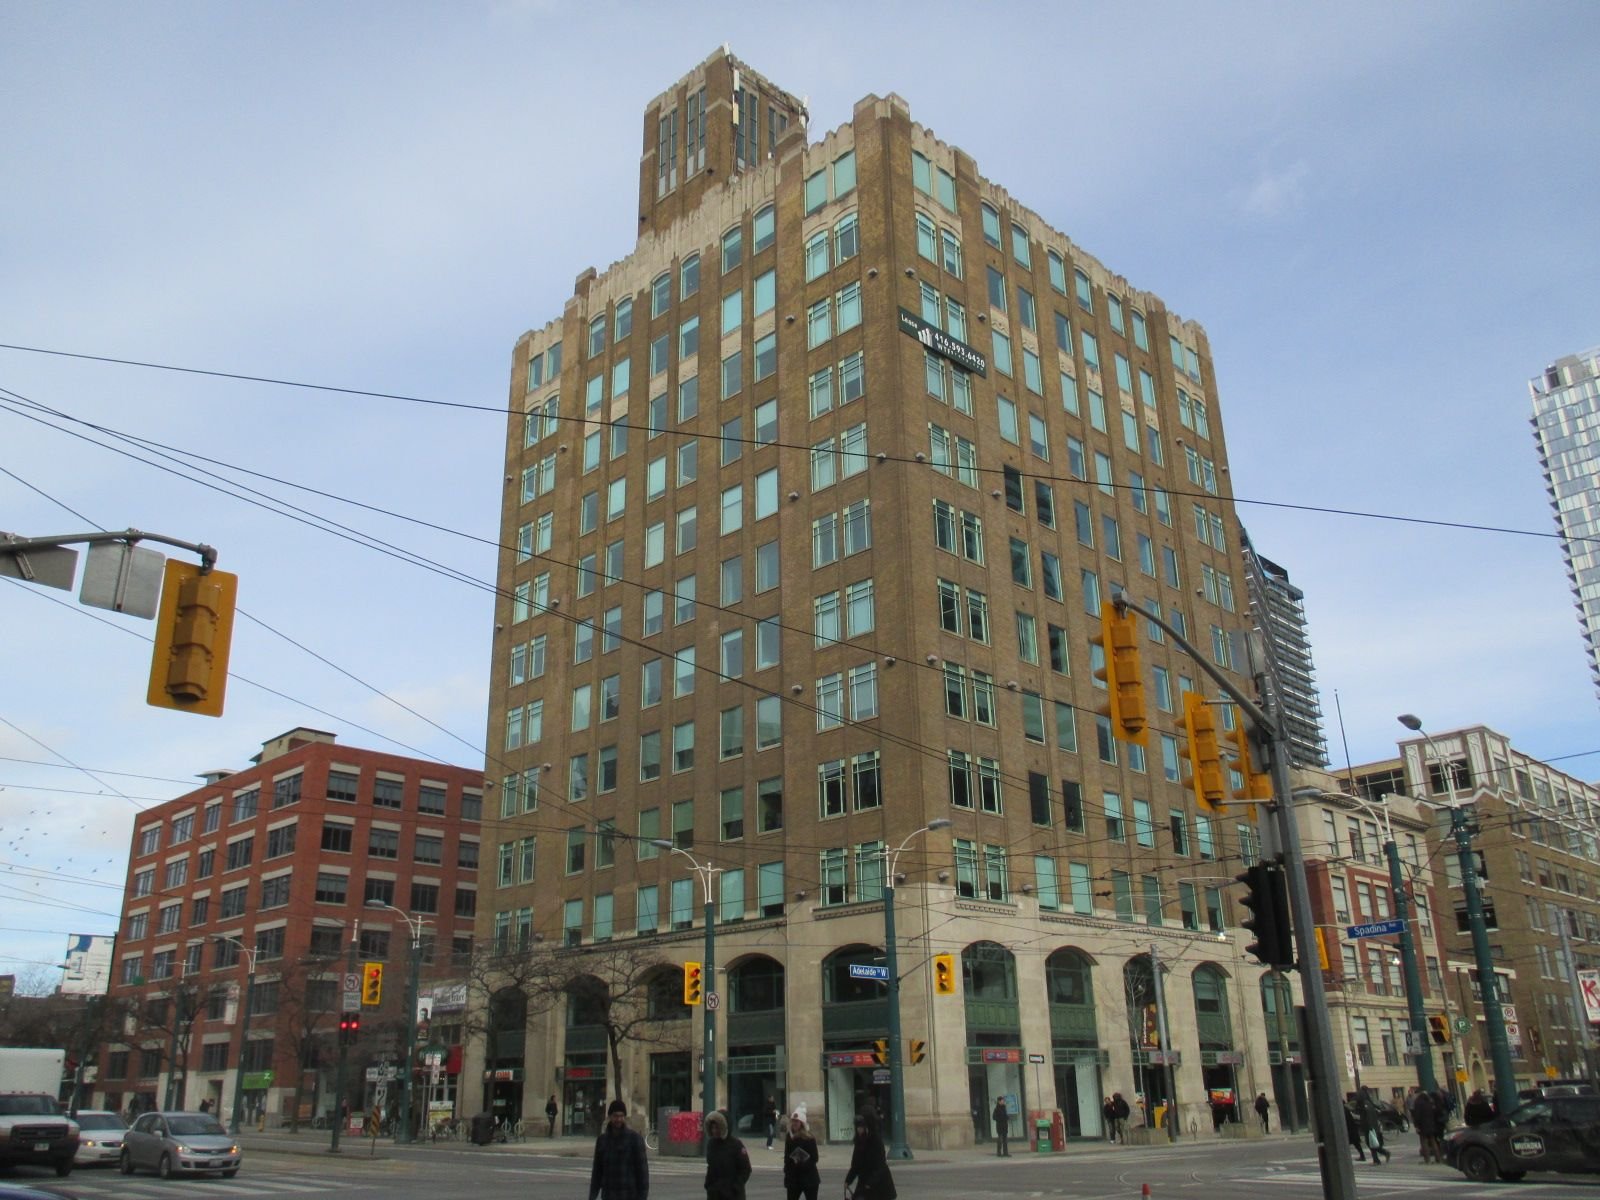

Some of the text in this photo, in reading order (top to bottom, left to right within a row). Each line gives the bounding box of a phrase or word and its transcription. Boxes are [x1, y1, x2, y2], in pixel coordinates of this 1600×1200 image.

[934, 332, 985, 368] 416.593.6420
[1353, 924, 1388, 937] Spadina
[852, 966, 877, 976] Adelaide
[880, 968, 887, 977] W
